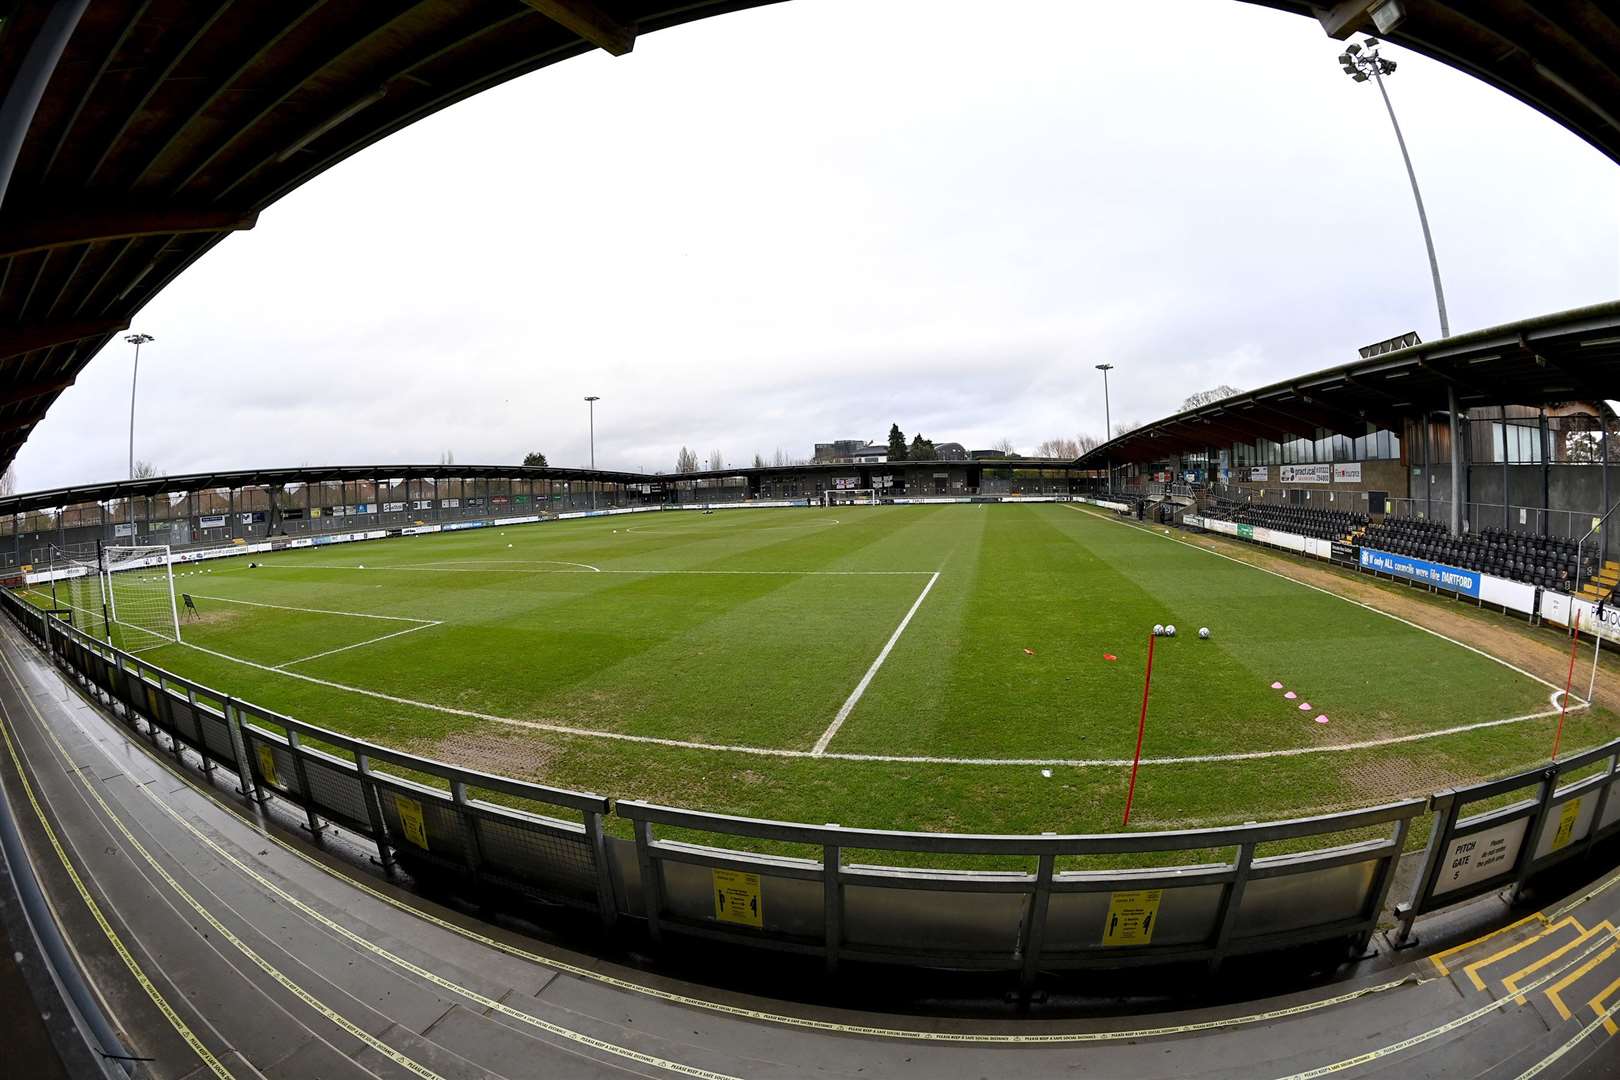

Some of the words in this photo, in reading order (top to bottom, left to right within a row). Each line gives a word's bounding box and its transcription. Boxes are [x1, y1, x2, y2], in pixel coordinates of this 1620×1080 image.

[1295, 466, 1315, 476] practical
[1374, 558, 1384, 569] only
[1384, 558, 1393, 569] ALL
[1395, 563, 1414, 574] councils
[1416, 568, 1428, 578] were
[1430, 569, 1440, 581] like
[1442, 571, 1472, 589] DARTFORD
[1456, 841, 1476, 854] PITCH
[1452, 855, 1470, 868] GATE
[1453, 870, 1460, 880] 5
